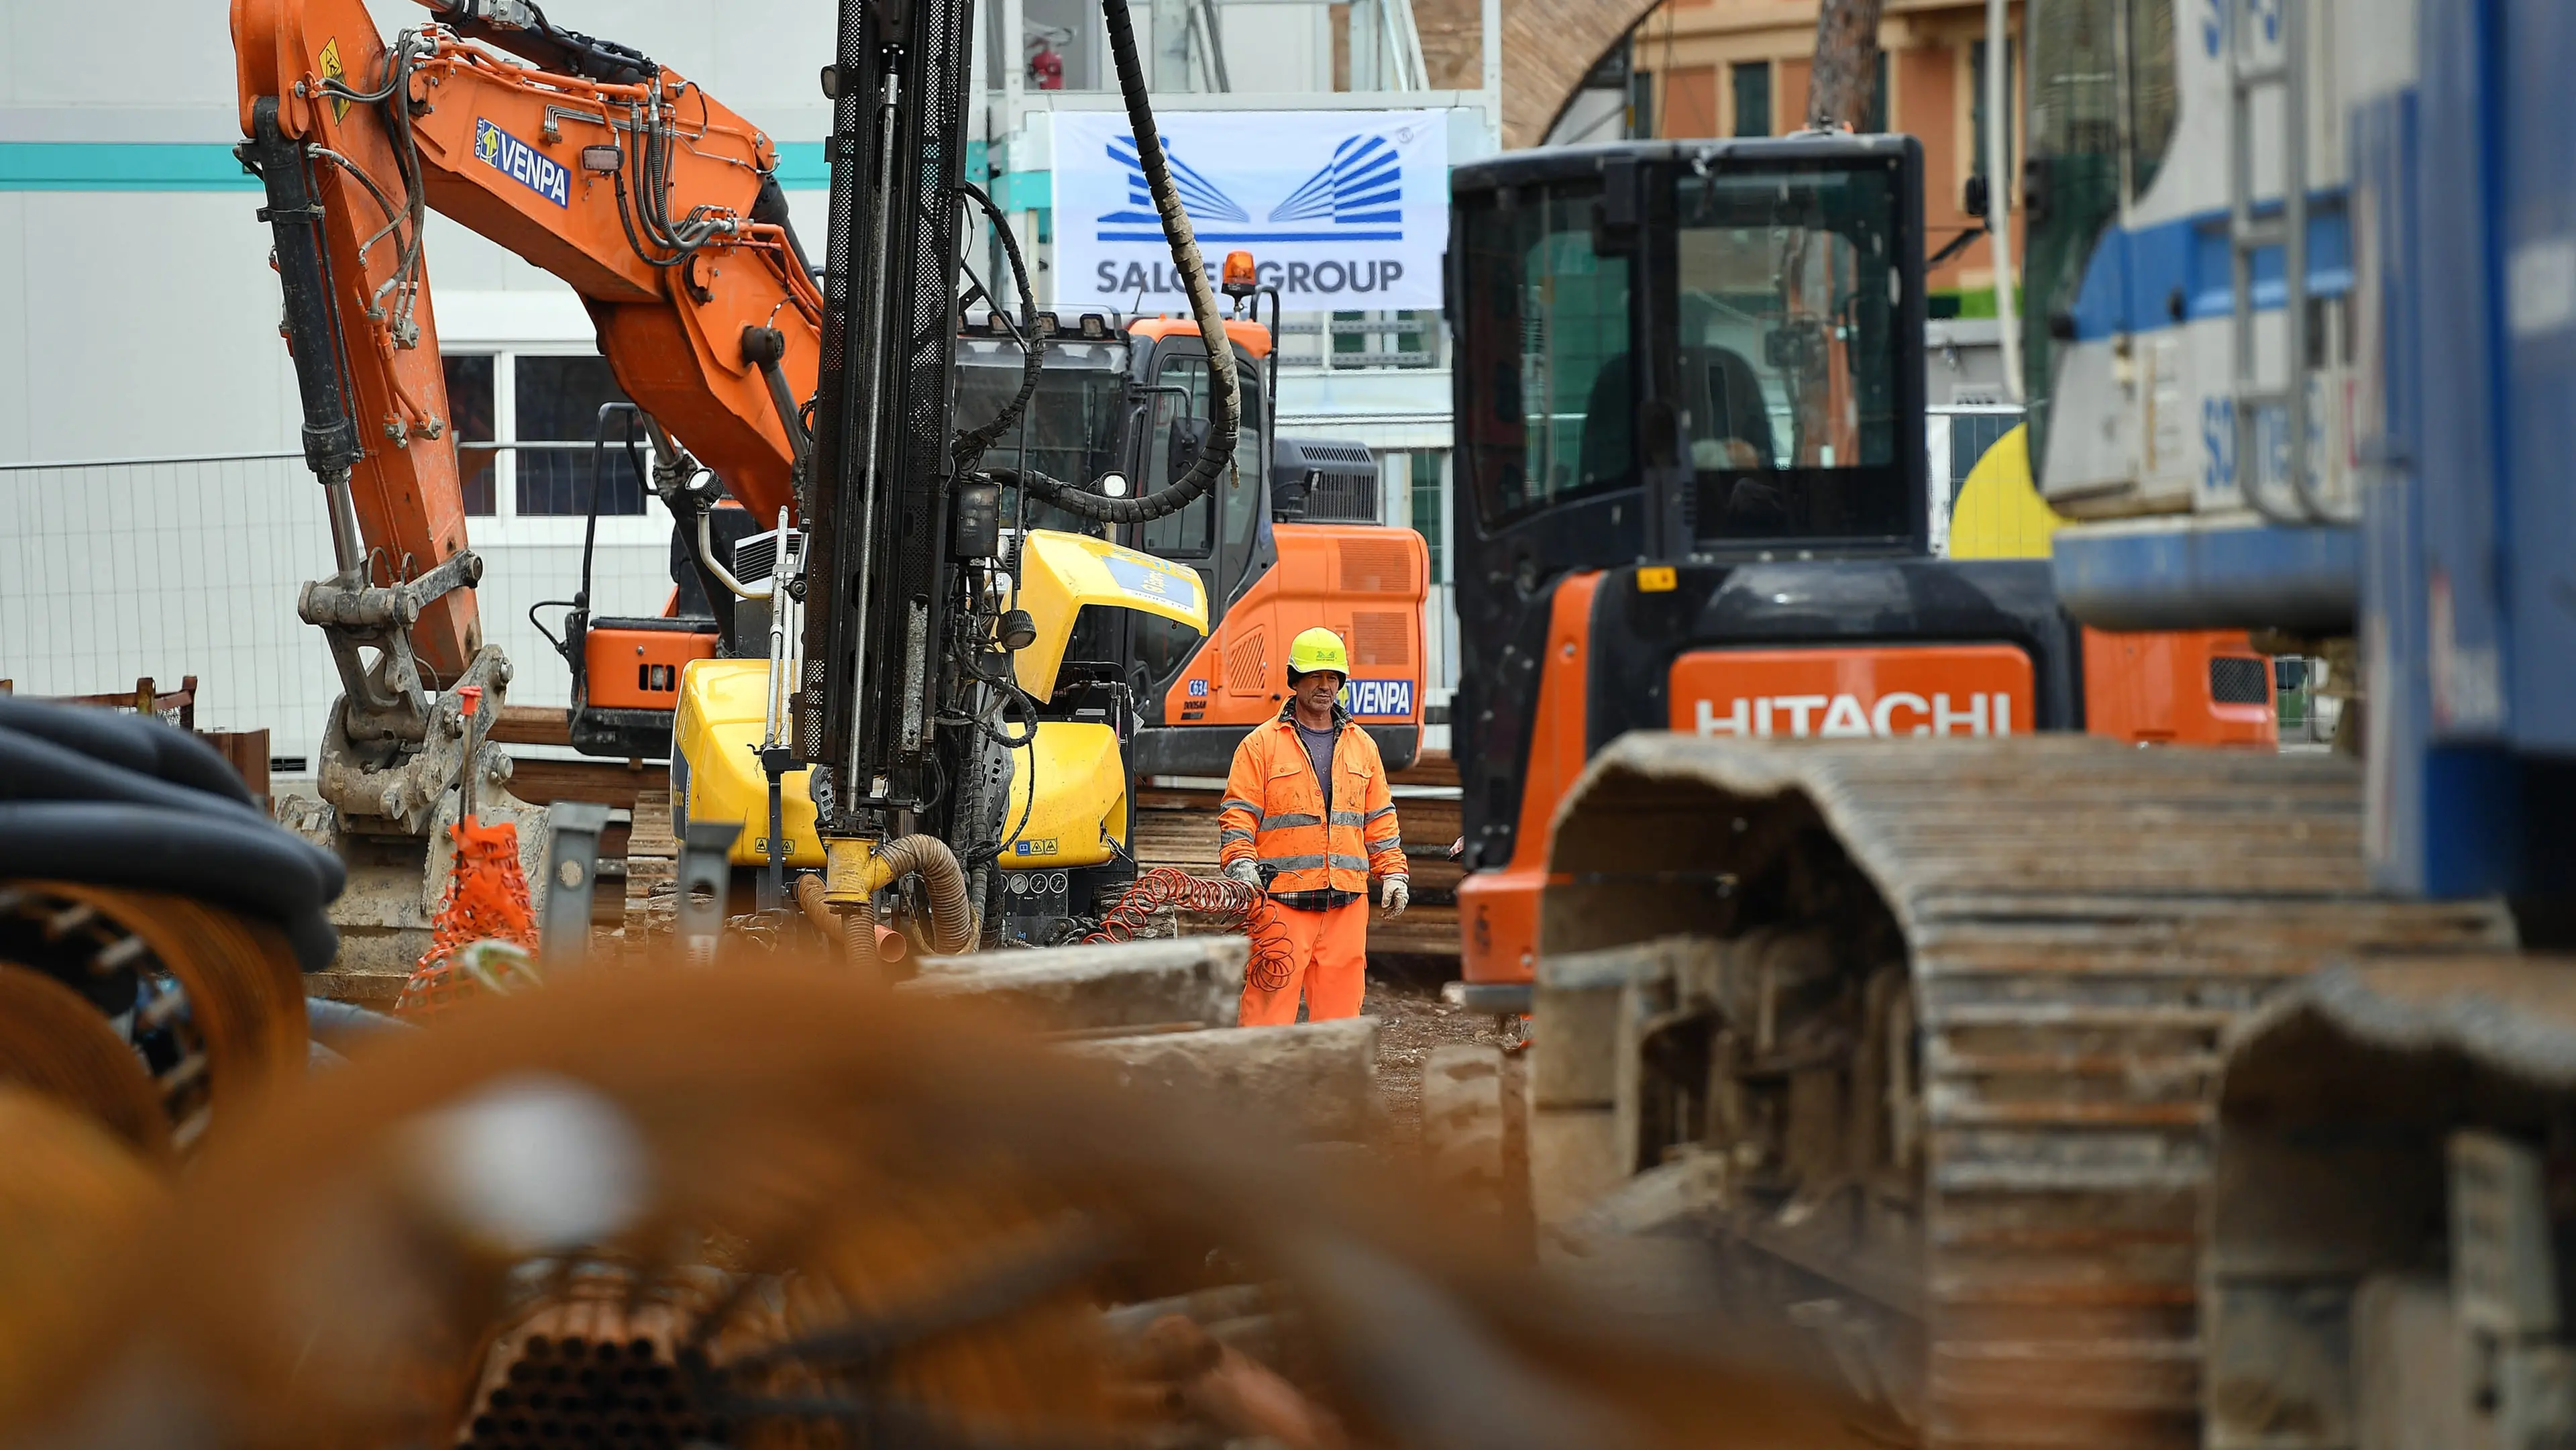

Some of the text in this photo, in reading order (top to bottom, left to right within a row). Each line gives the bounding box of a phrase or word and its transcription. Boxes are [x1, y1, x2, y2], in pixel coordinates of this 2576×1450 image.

[501, 134, 566, 205] VENPA
[1254, 260, 1403, 293] GROUP
[1352, 681, 1410, 714] VENPA
[1695, 691, 2011, 737] HITACHI
